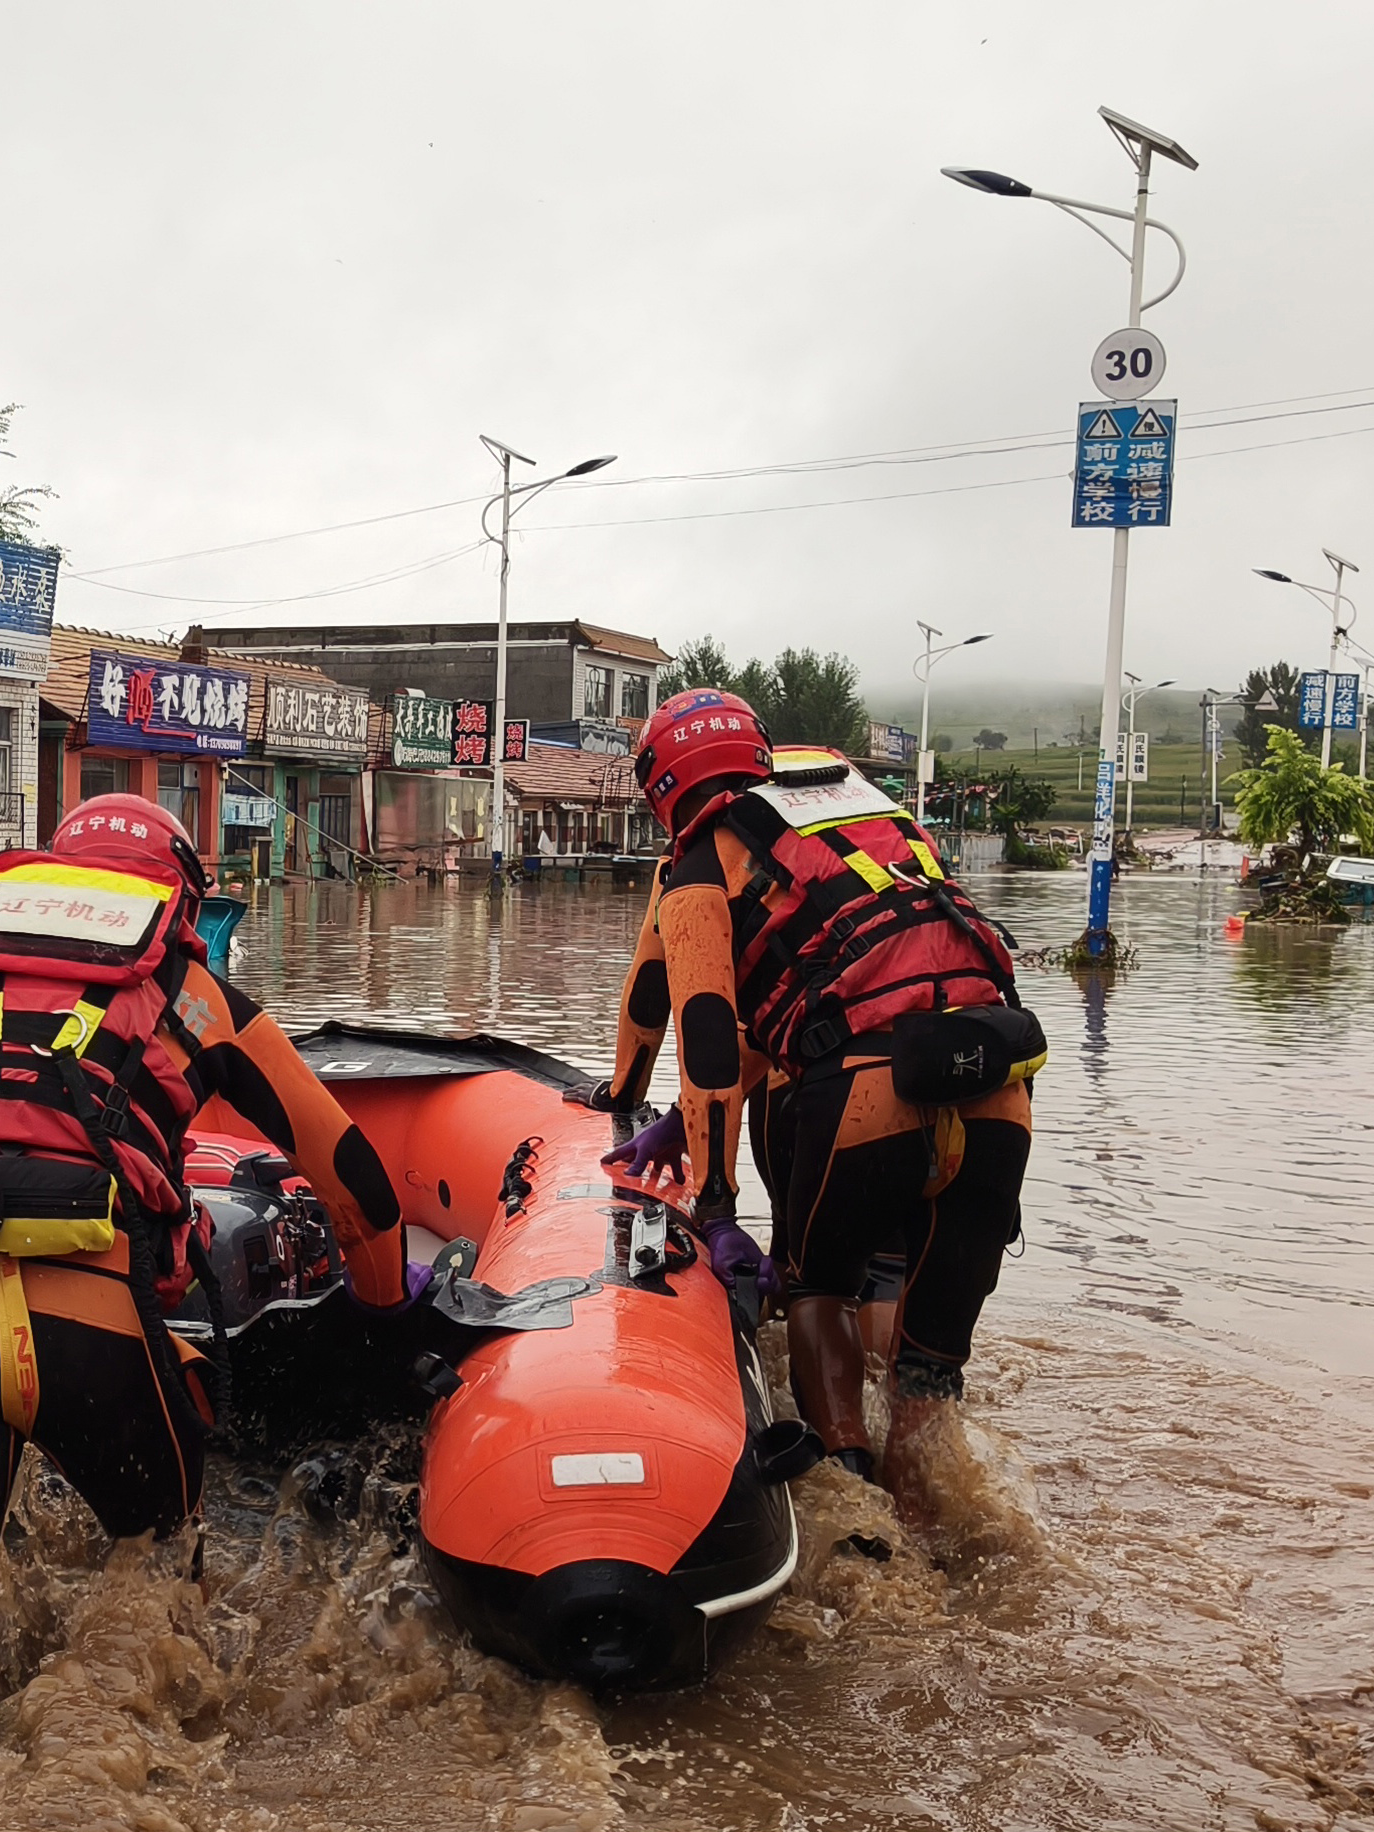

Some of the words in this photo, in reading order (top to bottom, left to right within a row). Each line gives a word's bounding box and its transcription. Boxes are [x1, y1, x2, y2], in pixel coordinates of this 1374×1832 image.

[1105, 347, 1153, 381] 30
[1081, 442, 1121, 521] 前方学校
[1127, 441, 1167, 521] 减速慢行
[267, 686, 369, 741] 顺利石艺装饰
[1302, 675, 1325, 726] 减速慢行
[1334, 675, 1356, 726] 前方学校
[453, 703, 487, 764] 烧烤
[506, 723, 524, 759] 烧烤
[673, 717, 742, 743] 辽宁机动
[778, 786, 872, 808] 辽宁机动
[68, 815, 149, 840] 辽宁机动
[0, 897, 130, 928] 辽宁机动
